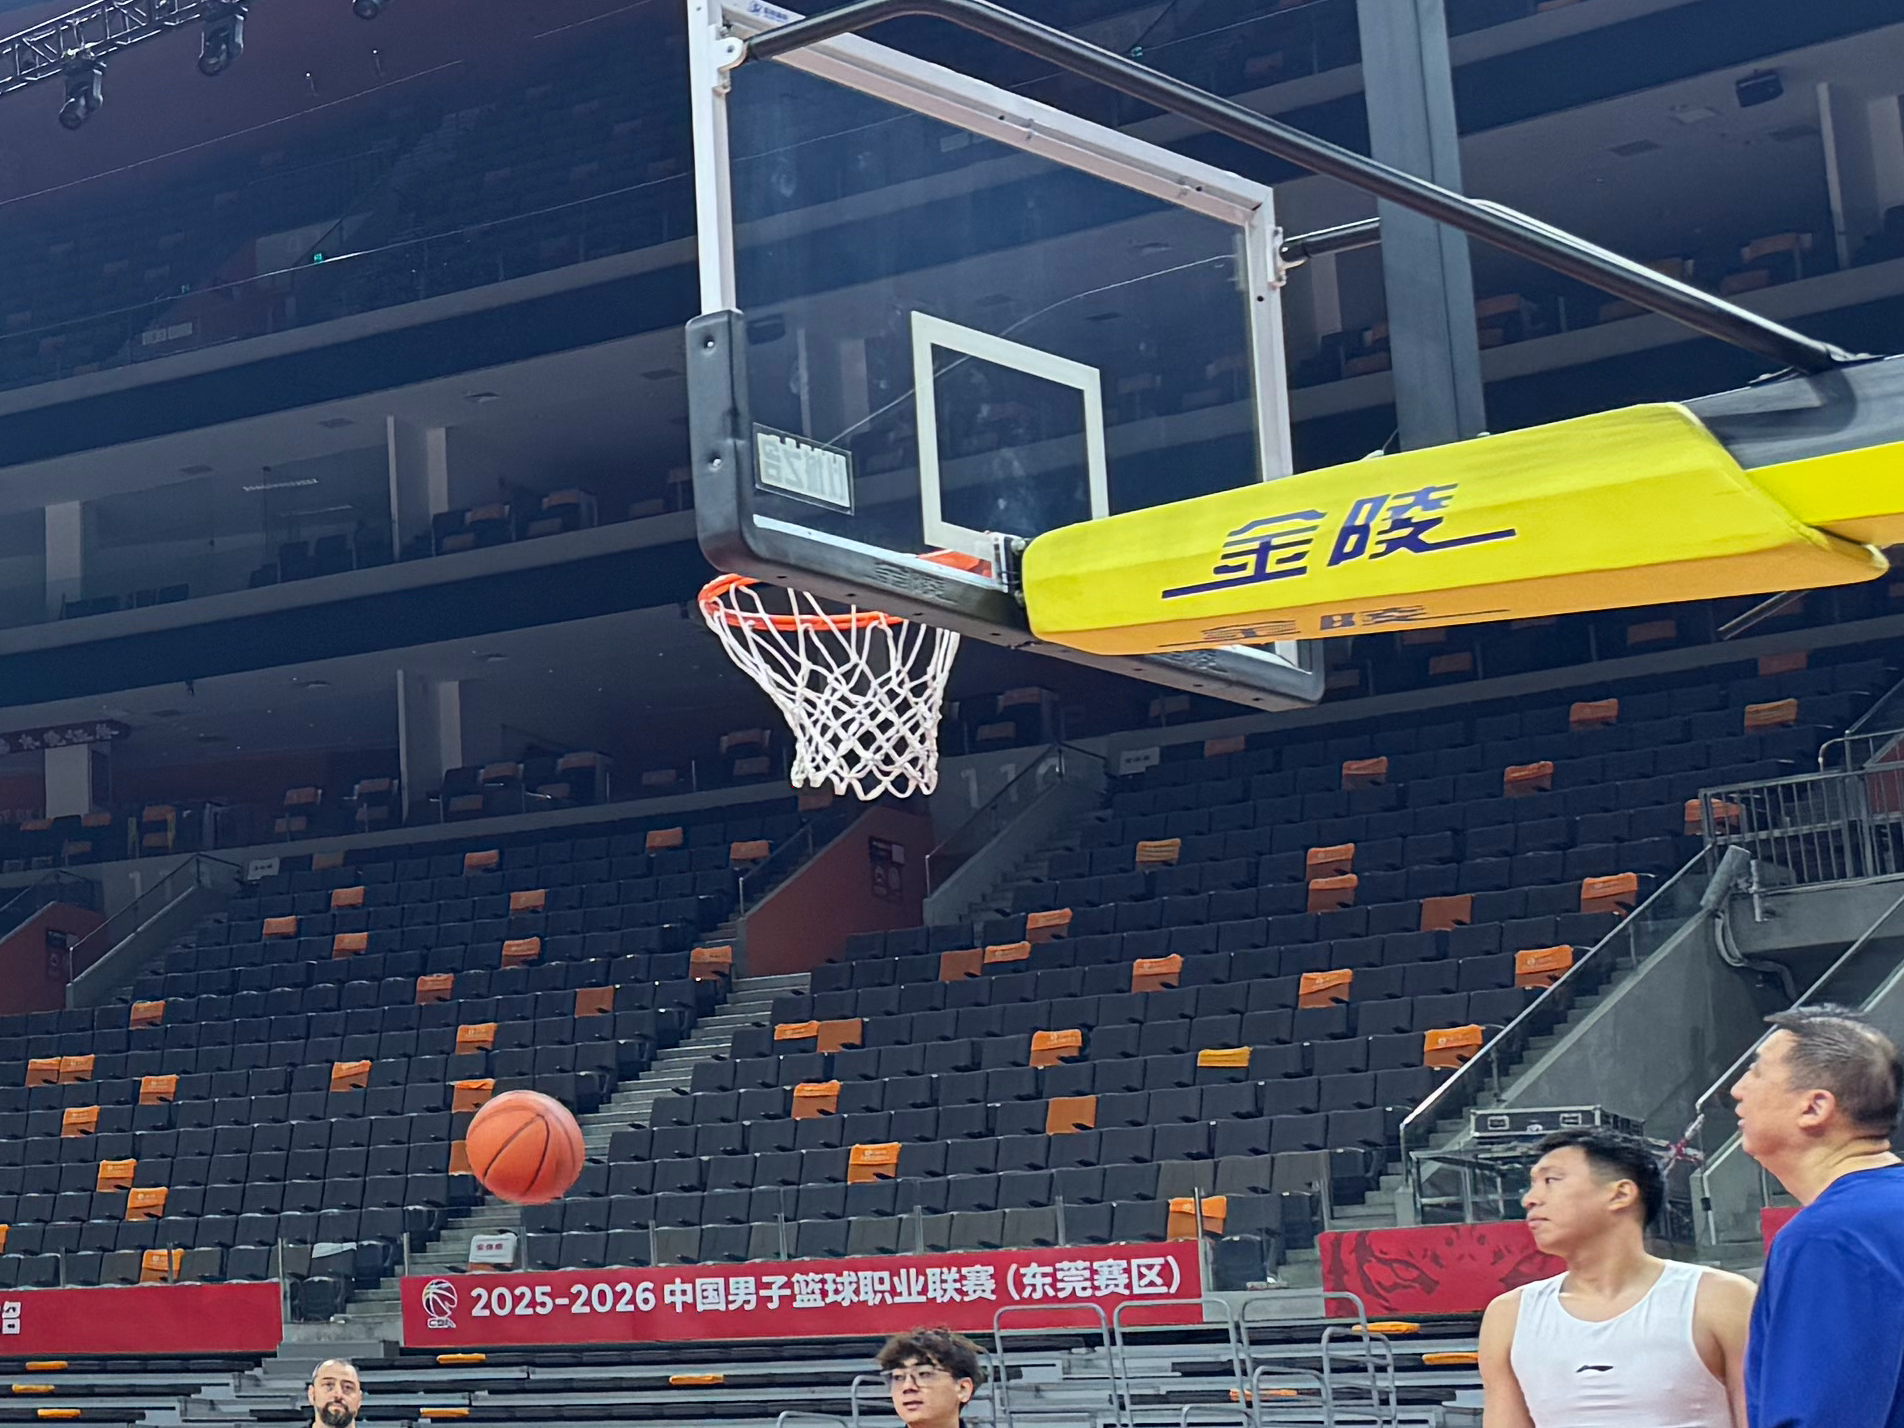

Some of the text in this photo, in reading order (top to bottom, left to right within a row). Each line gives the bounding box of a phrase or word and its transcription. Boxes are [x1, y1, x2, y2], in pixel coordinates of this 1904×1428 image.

[471, 1281, 656, 1317] 2025-2026
[663, 1263, 997, 1313] 中国男子篮球职业联赛
